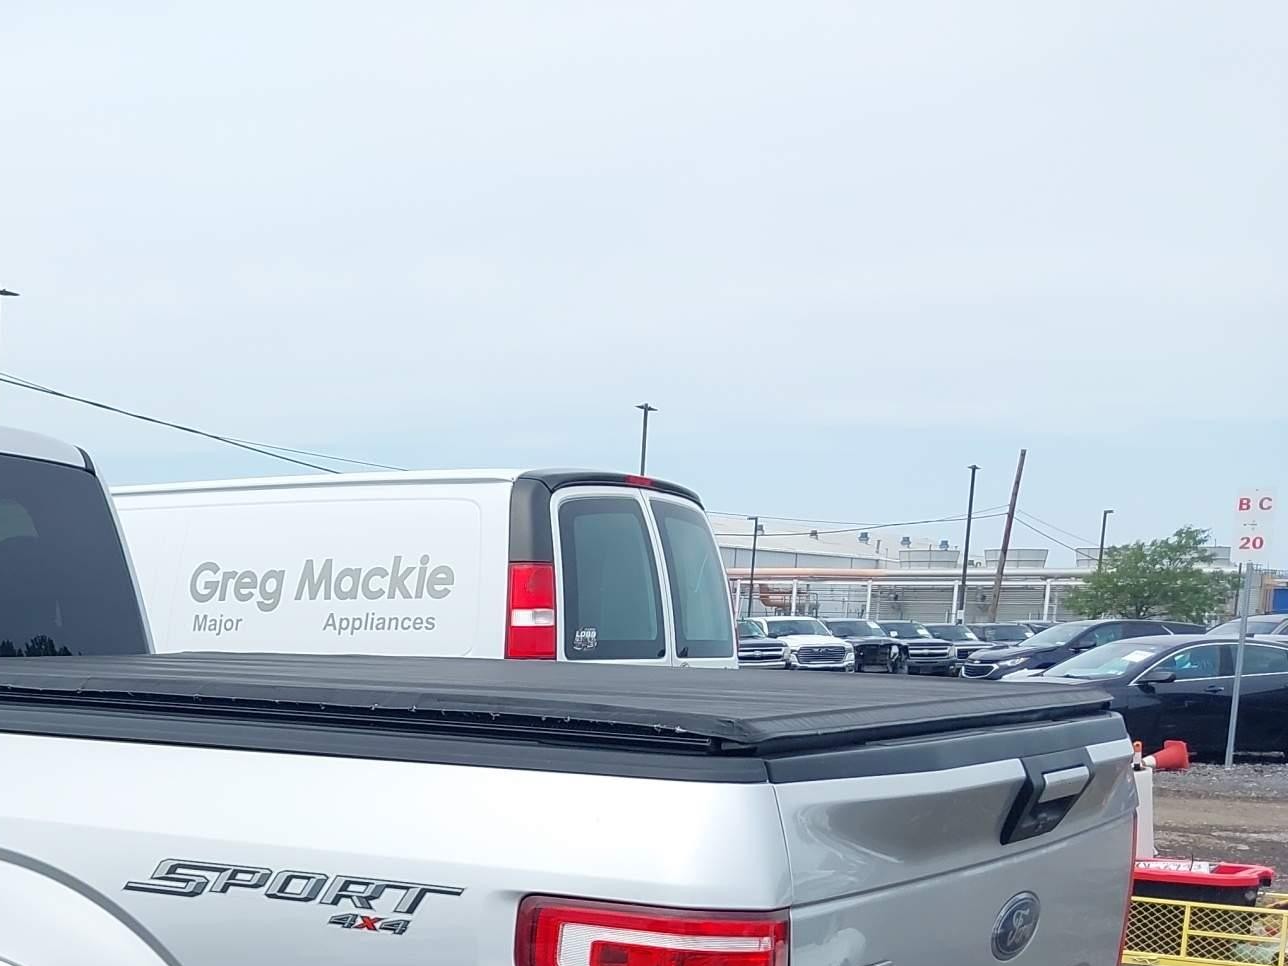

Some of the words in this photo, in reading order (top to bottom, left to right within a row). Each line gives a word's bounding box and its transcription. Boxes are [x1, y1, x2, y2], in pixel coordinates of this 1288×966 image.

[1238, 497, 1252, 511] B
[1258, 496, 1273, 511] C
[1238, 536, 1264, 550] 20
[189, 561, 286, 613] Greg
[294, 554, 455, 601] Mackie
[192, 614, 244, 637] Major
[322, 612, 437, 636] Appliances
[122, 857, 466, 915] SPORT
